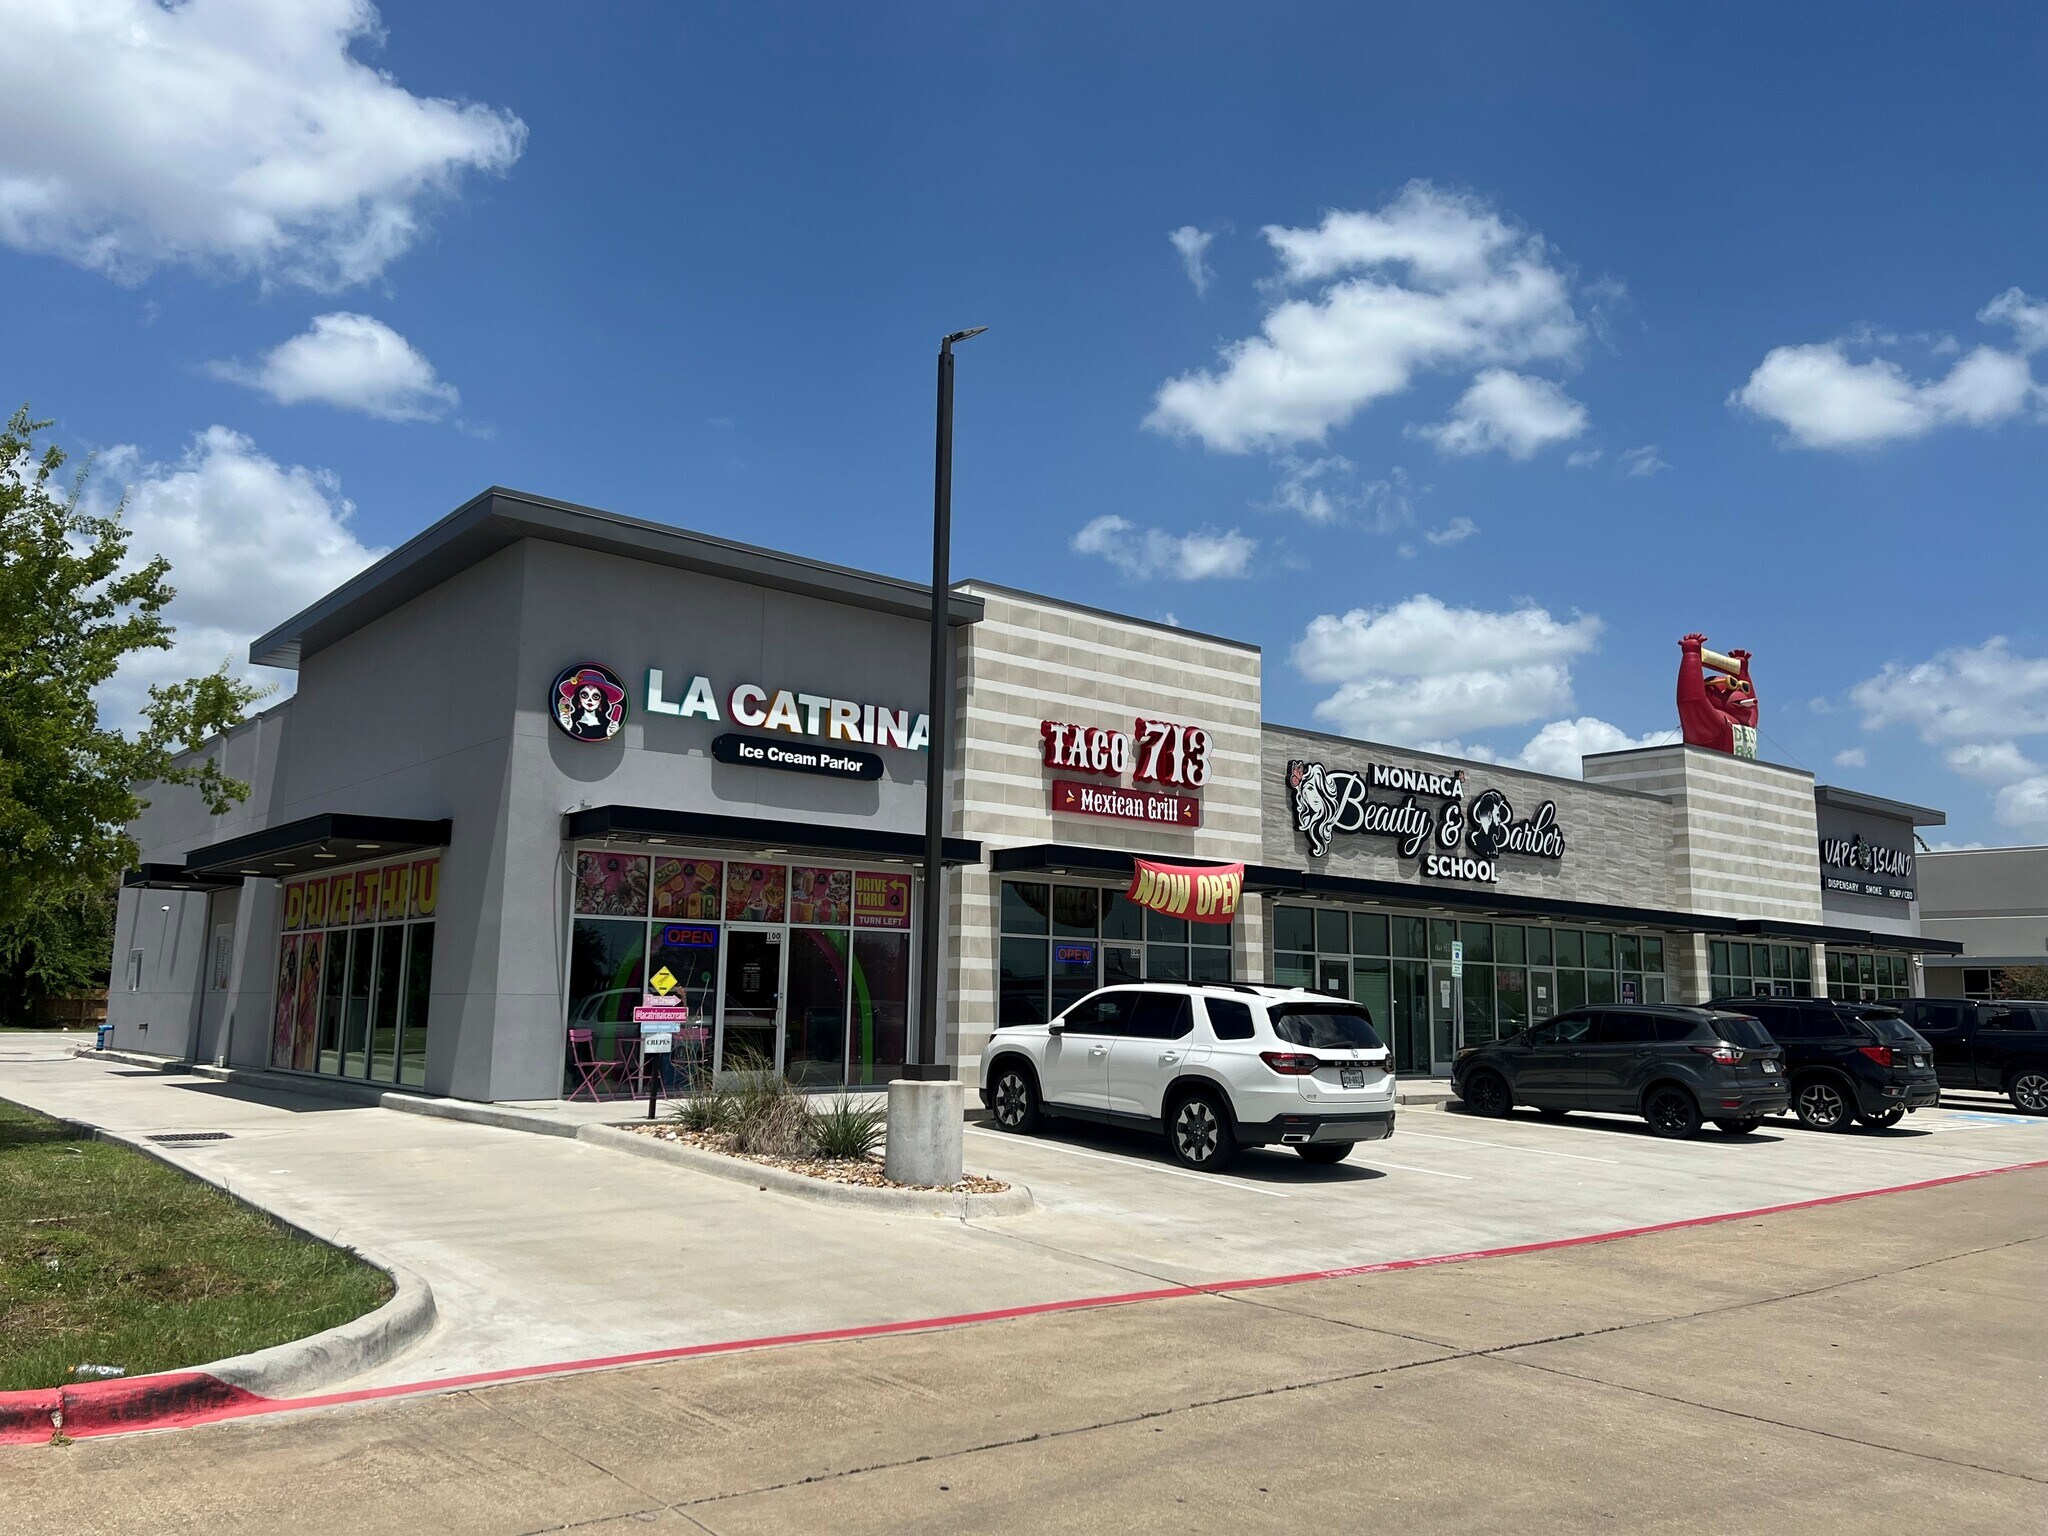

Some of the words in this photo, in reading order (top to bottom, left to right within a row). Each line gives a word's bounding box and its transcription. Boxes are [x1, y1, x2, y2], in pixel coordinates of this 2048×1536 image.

[646, 667, 720, 721] LA
[728, 683, 930, 753] CATRINA
[738, 742, 765, 760] Ice
[767, 747, 818, 767] Cream
[820, 753, 863, 773] Parlor
[1044, 722, 1130, 775] TACO
[1136, 719, 1214, 788] 713
[1373, 765, 1465, 798] MONARCA
[1080, 787, 1144, 818] Mexican
[1148, 797, 1179, 822] Grill
[1325, 772, 1431, 856] Beauty
[1442, 805, 1463, 846] &
[1471, 799, 1564, 857] Barber
[1427, 857, 1500, 883] SCHOOL
[1824, 838, 1858, 869] VAPE
[1871, 846, 1913, 877] ISLAND
[286, 862, 440, 929] DRIVE-THRU
[855, 877, 888, 892] DRIVE
[1132, 868, 1190, 914] NOW
[1828, 879, 1860, 891] DISPENSARY
[1865, 885, 1883, 896] SMOKE
[856, 892, 886, 907] THRU
[859, 916, 882, 925] TURN
[883, 918, 903, 926] LEFT
[667, 928, 714, 944] OPEN
[767, 932, 781, 940] 100
[1058, 948, 1090, 960] OPEN
[1130, 948, 1140, 956] 200
